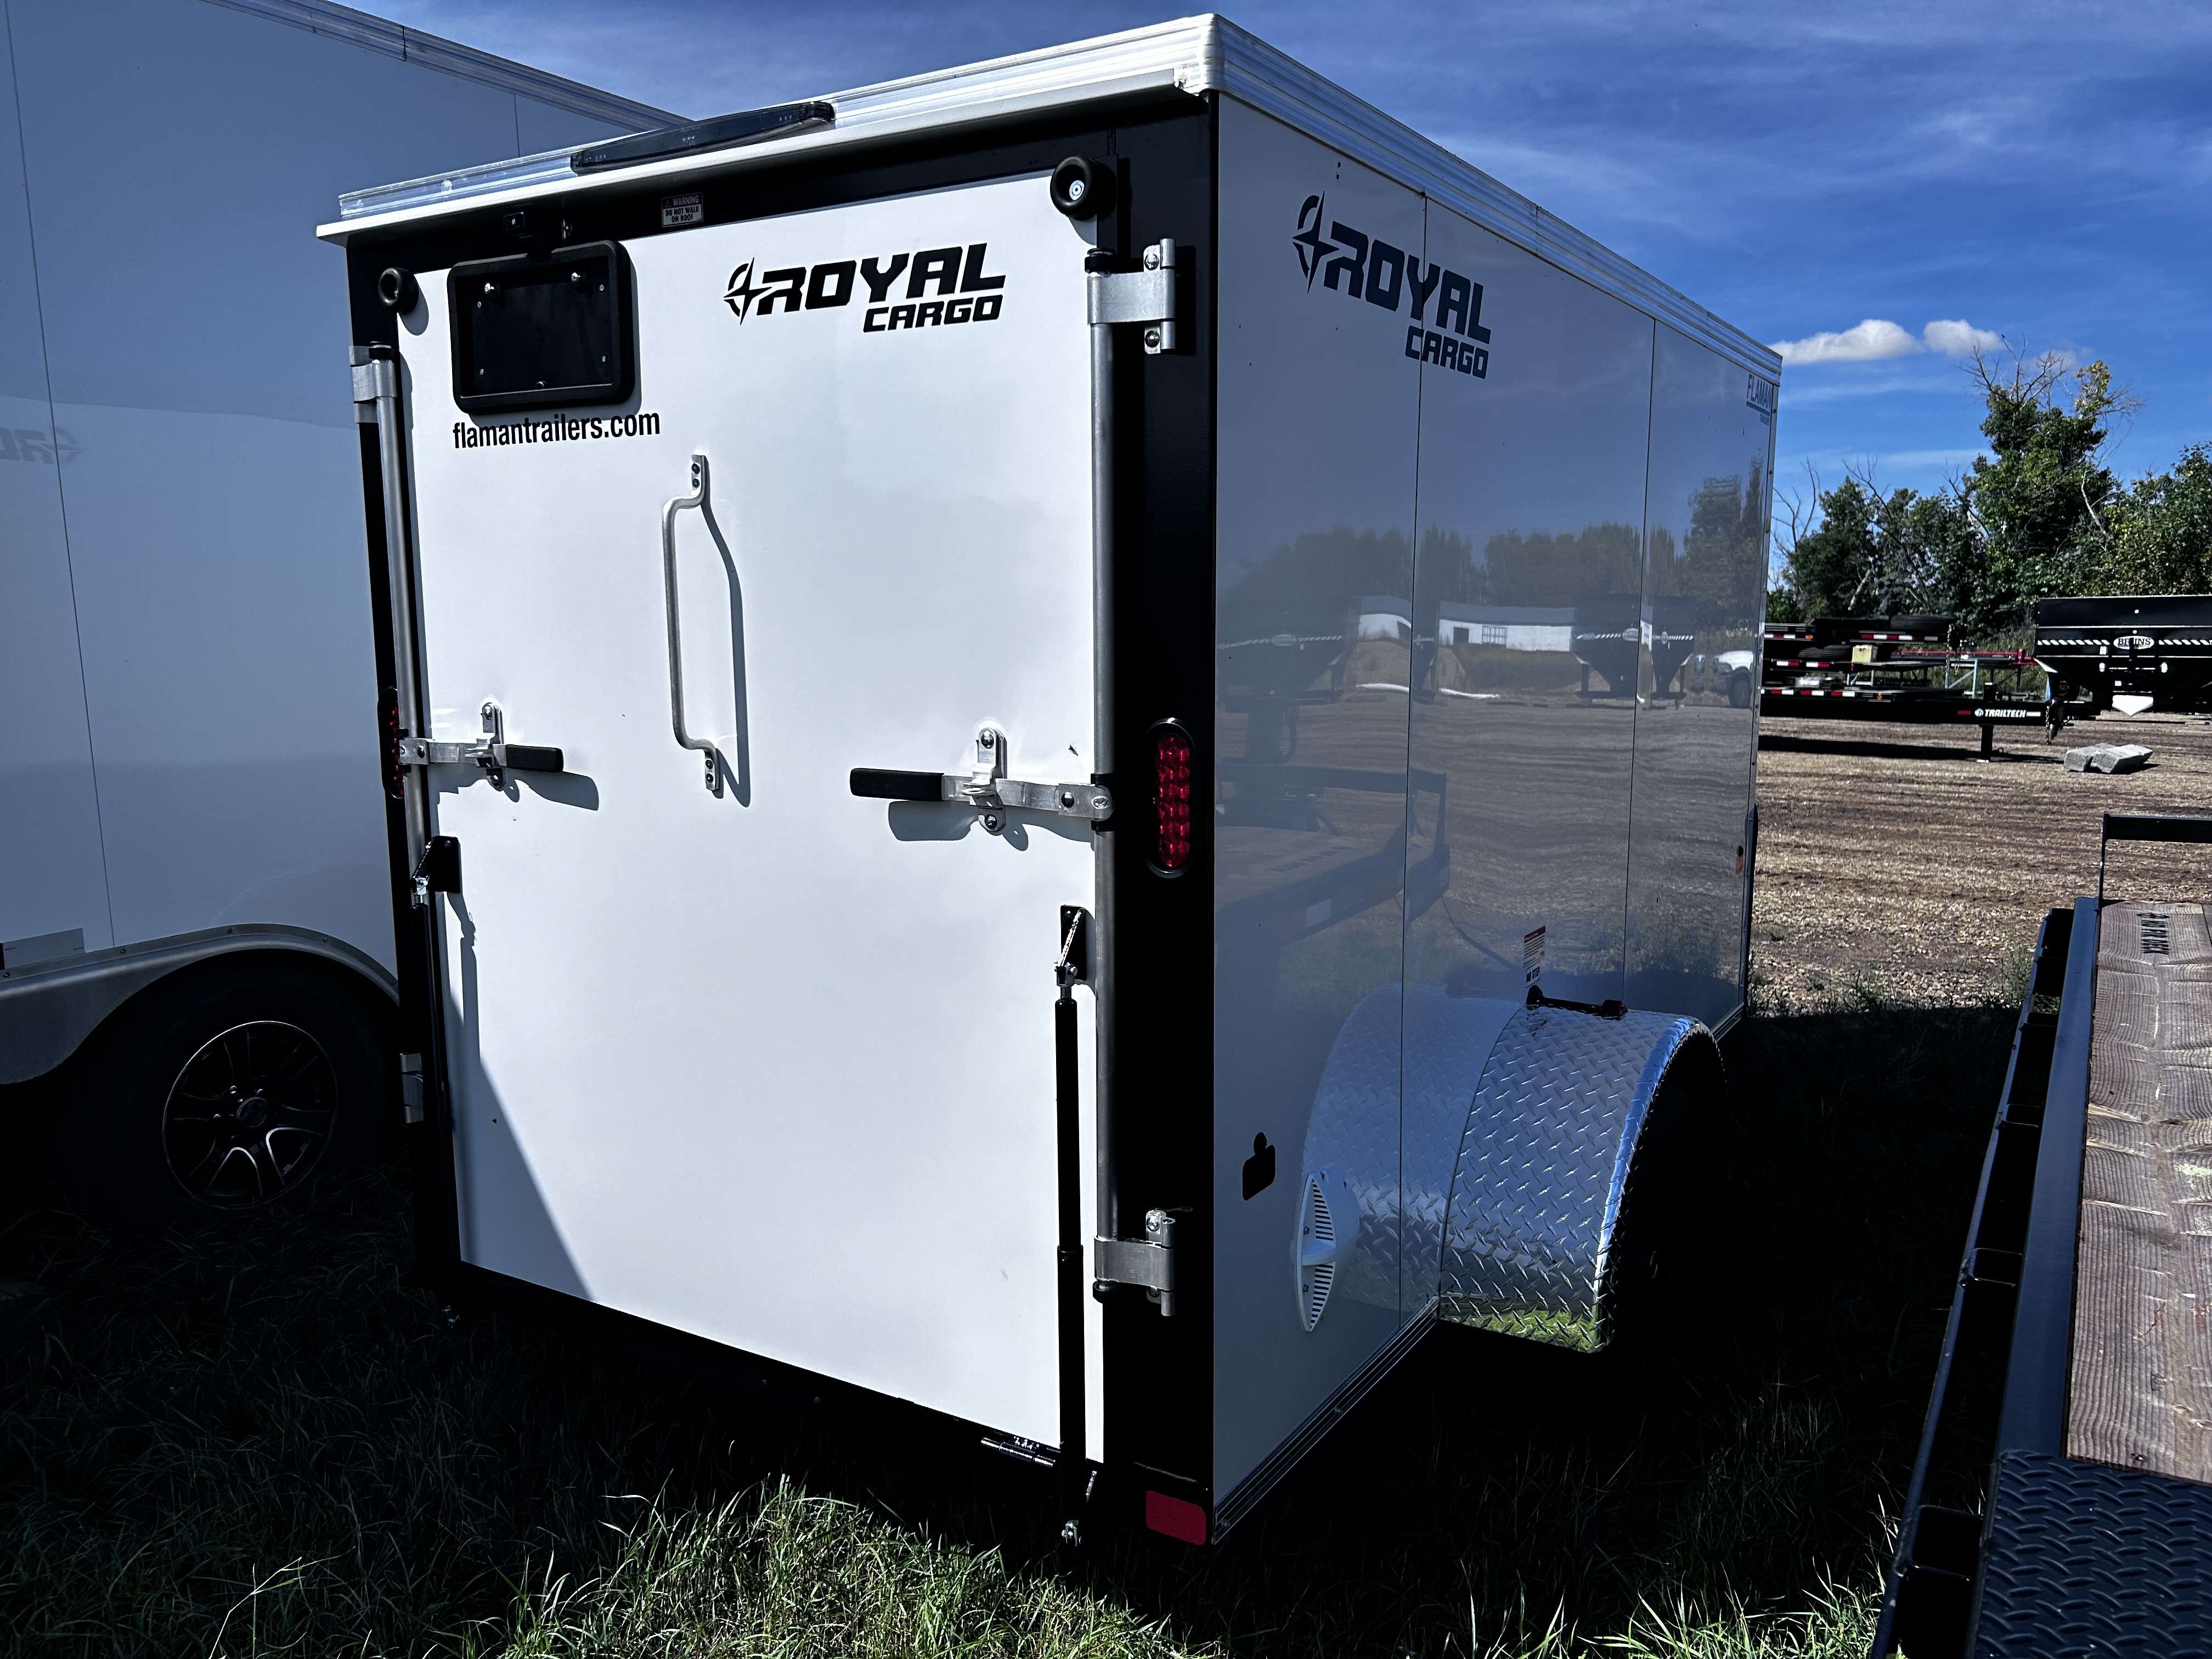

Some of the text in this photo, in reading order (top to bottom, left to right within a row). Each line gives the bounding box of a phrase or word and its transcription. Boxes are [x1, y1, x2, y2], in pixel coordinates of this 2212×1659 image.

[673, 195, 699, 206] WARNING
[685, 206, 699, 214] WALK
[757, 242, 1006, 317] ROYAL
[1323, 220, 1492, 345] ROYAL
[863, 295, 1003, 333] CARGO
[1405, 325, 1489, 379] CARGO
[1747, 374, 1770, 410] FLAMAN
[453, 412, 661, 449] flamantrailers.com
[2117, 637, 2151, 646] BRINS
[1984, 709, 2027, 718] TRAILTECH
[2142, 939, 2171, 955] DECK
[1526, 967, 1540, 983] NO STEP
